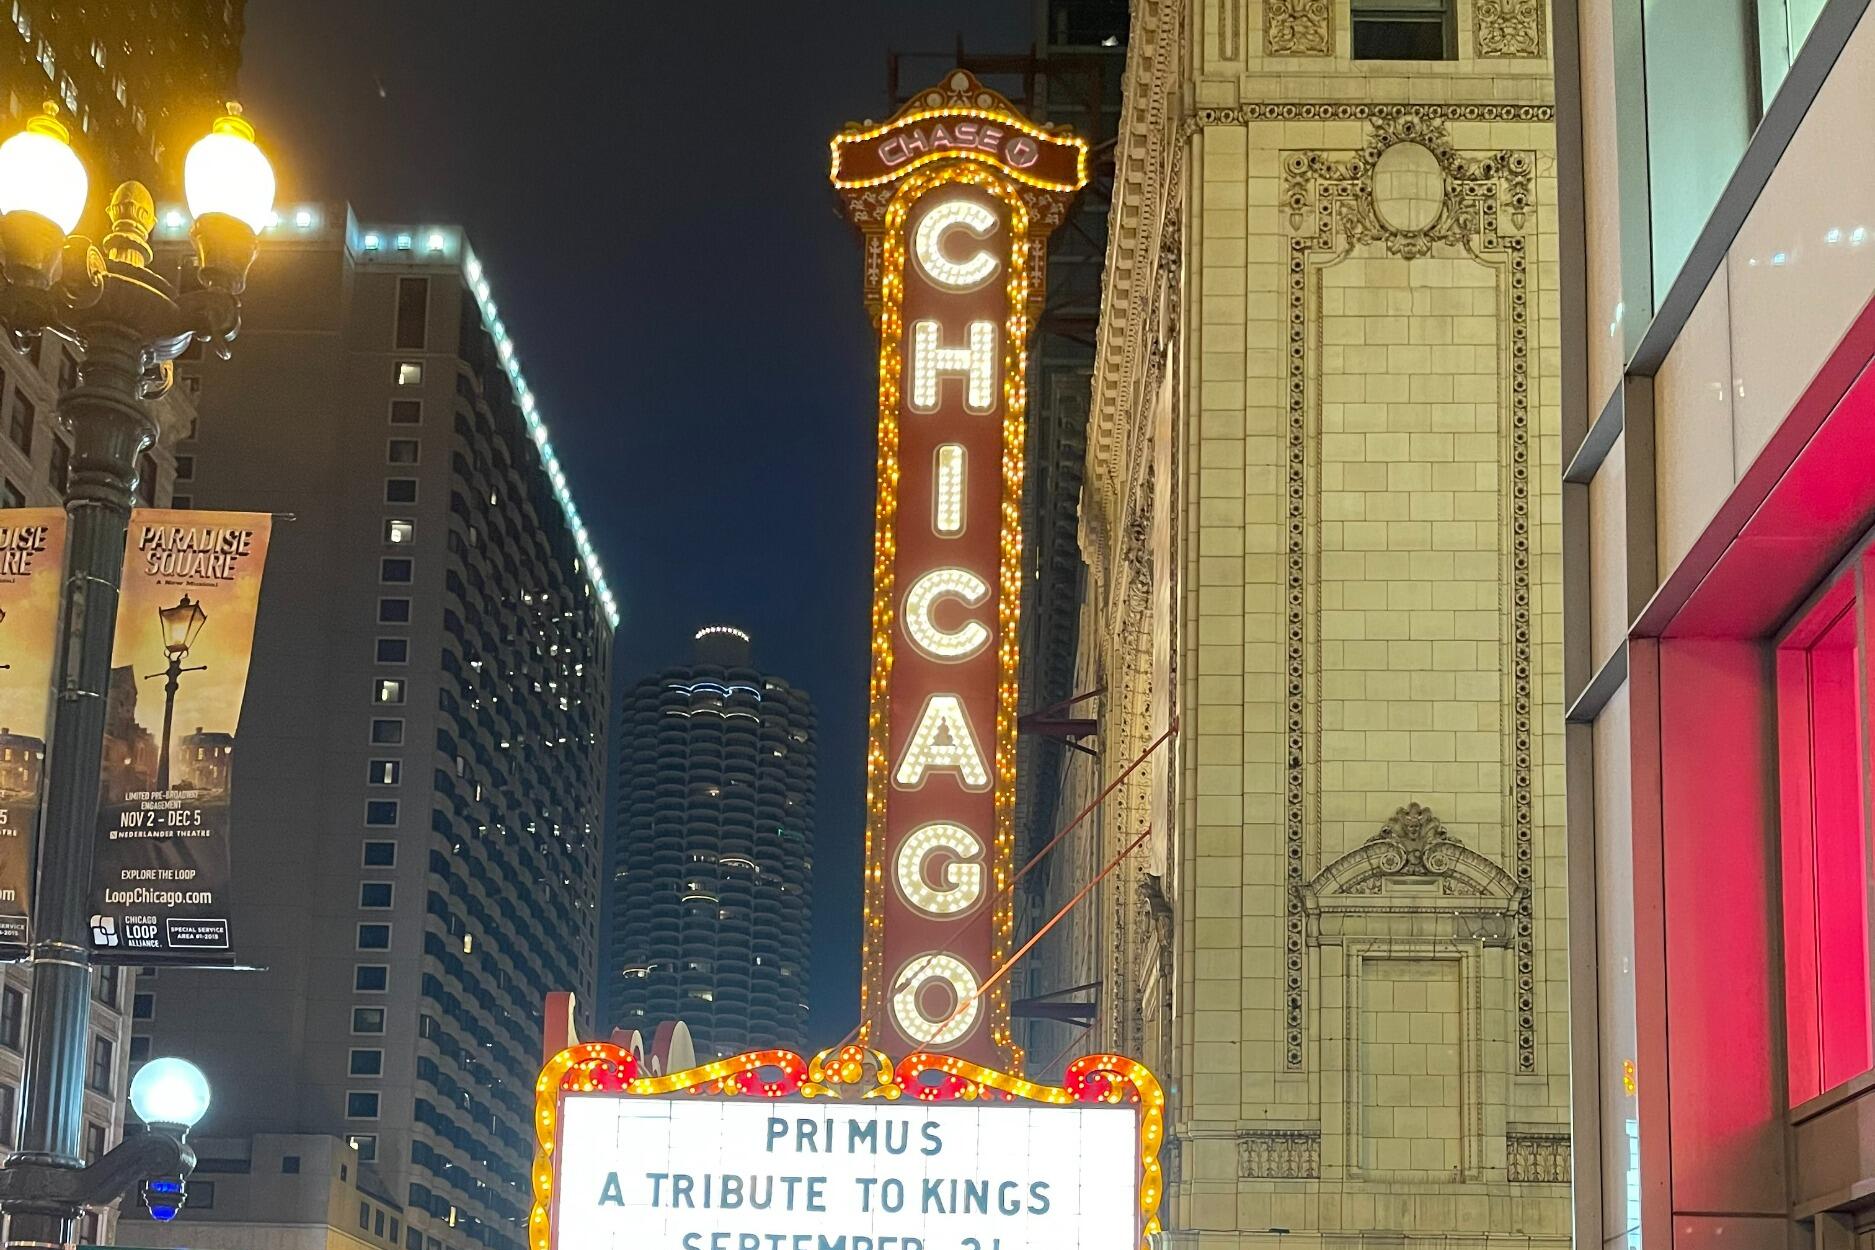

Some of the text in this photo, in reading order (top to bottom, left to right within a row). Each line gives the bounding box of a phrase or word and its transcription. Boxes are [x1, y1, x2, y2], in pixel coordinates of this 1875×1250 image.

[879, 122, 1003, 166] CHASE
[139, 526, 253, 556] PARADISE
[145, 550, 239, 580] SQUARE
[890, 198, 1000, 1048] CHICAGO
[125, 791, 150, 801] LIMITED
[141, 800, 182, 810] ENGAGEMENT
[120, 811, 145, 828] NOV
[147, 811, 155, 827] 2
[168, 810, 191, 826] DEC
[194, 809, 201, 825] 5
[177, 829, 211, 838] THEATRE
[121, 870, 196, 880] EXPLORE THE LOOP
[105, 888, 212, 907] LoopChicago.com
[125, 916, 157, 925] CHICAGO
[126, 925, 158, 939] LOOP
[766, 1117, 942, 1156] PRIMUS
[598, 1172, 1050, 1216] A TRIBUTE TO KINGS
